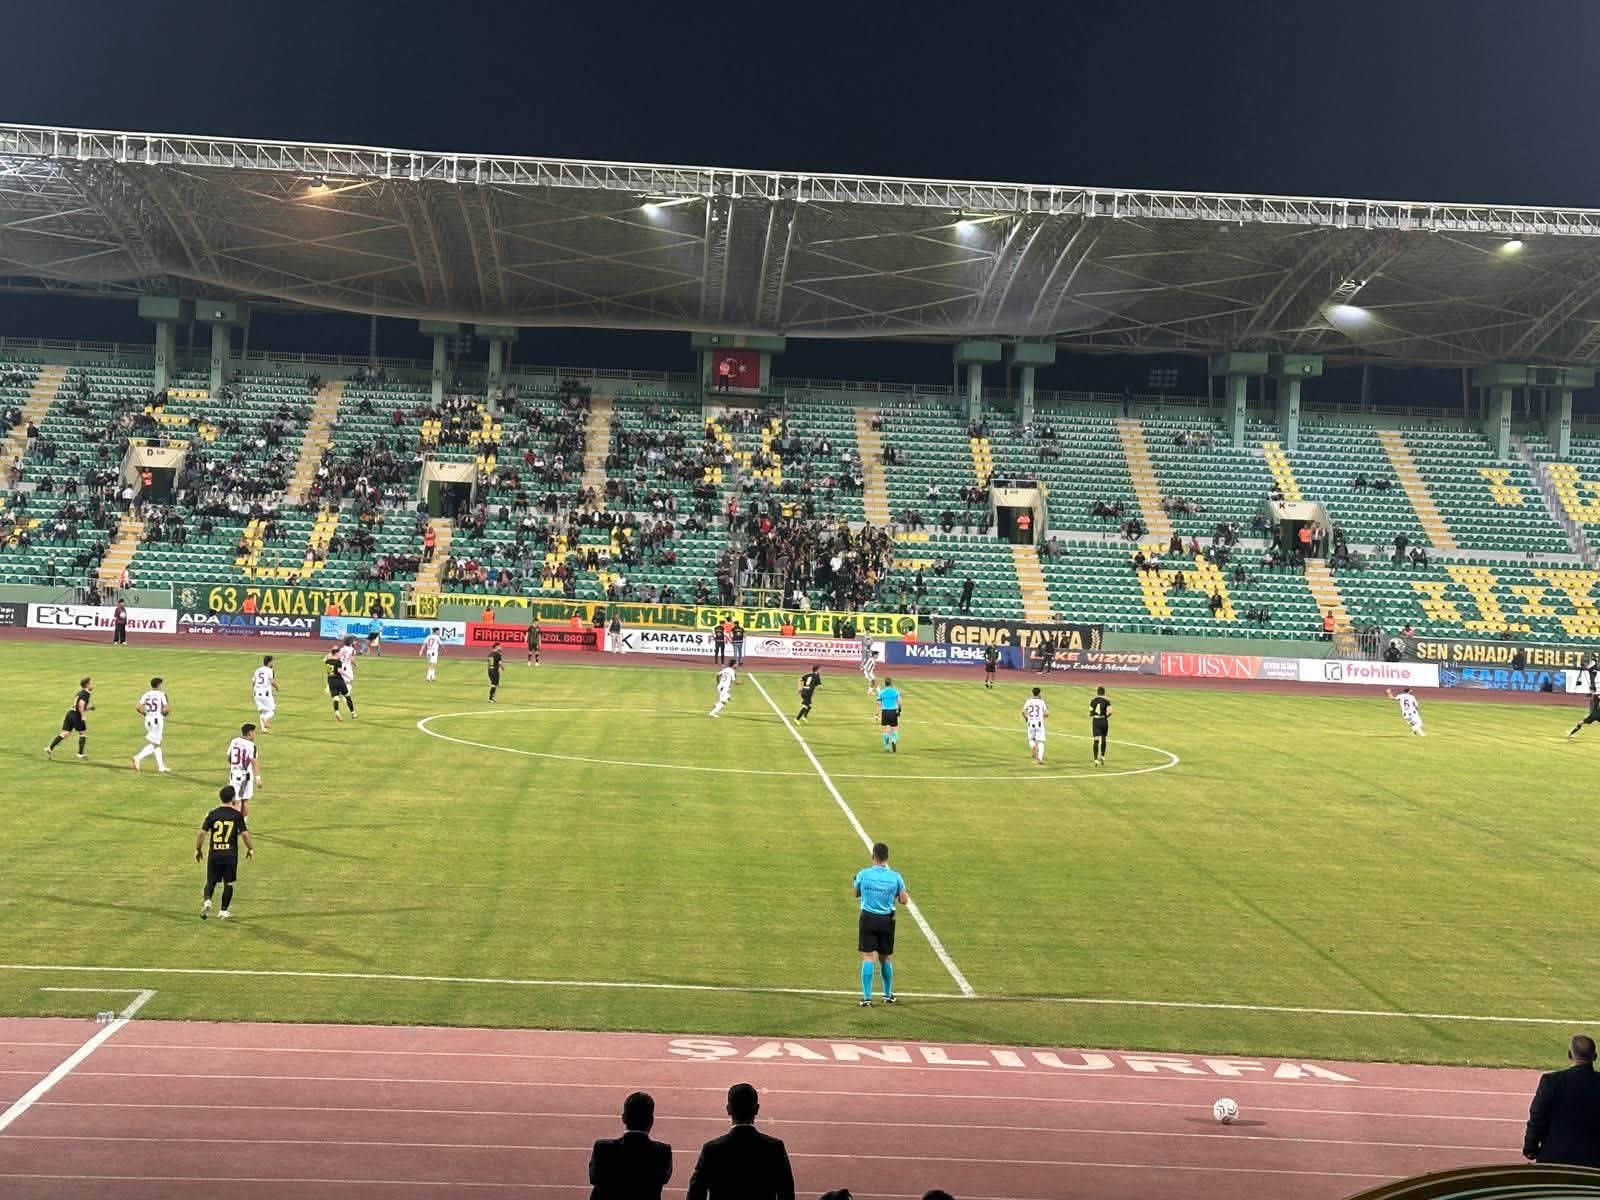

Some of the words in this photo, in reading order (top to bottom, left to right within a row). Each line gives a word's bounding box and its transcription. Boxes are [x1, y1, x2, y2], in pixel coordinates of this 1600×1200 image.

[208, 586, 239, 613] 63
[641, 632, 704, 646] KARATAŞ
[1416, 642, 1448, 660] SEN
[1525, 648, 1585, 668] TERLET
[258, 672, 265, 684] 5
[1346, 663, 1411, 679] frohline
[145, 698, 158, 712] 55
[1028, 704, 1040, 718] 23
[213, 820, 234, 843] 27
[666, 1038, 1361, 1082] ŞANLIURFA
